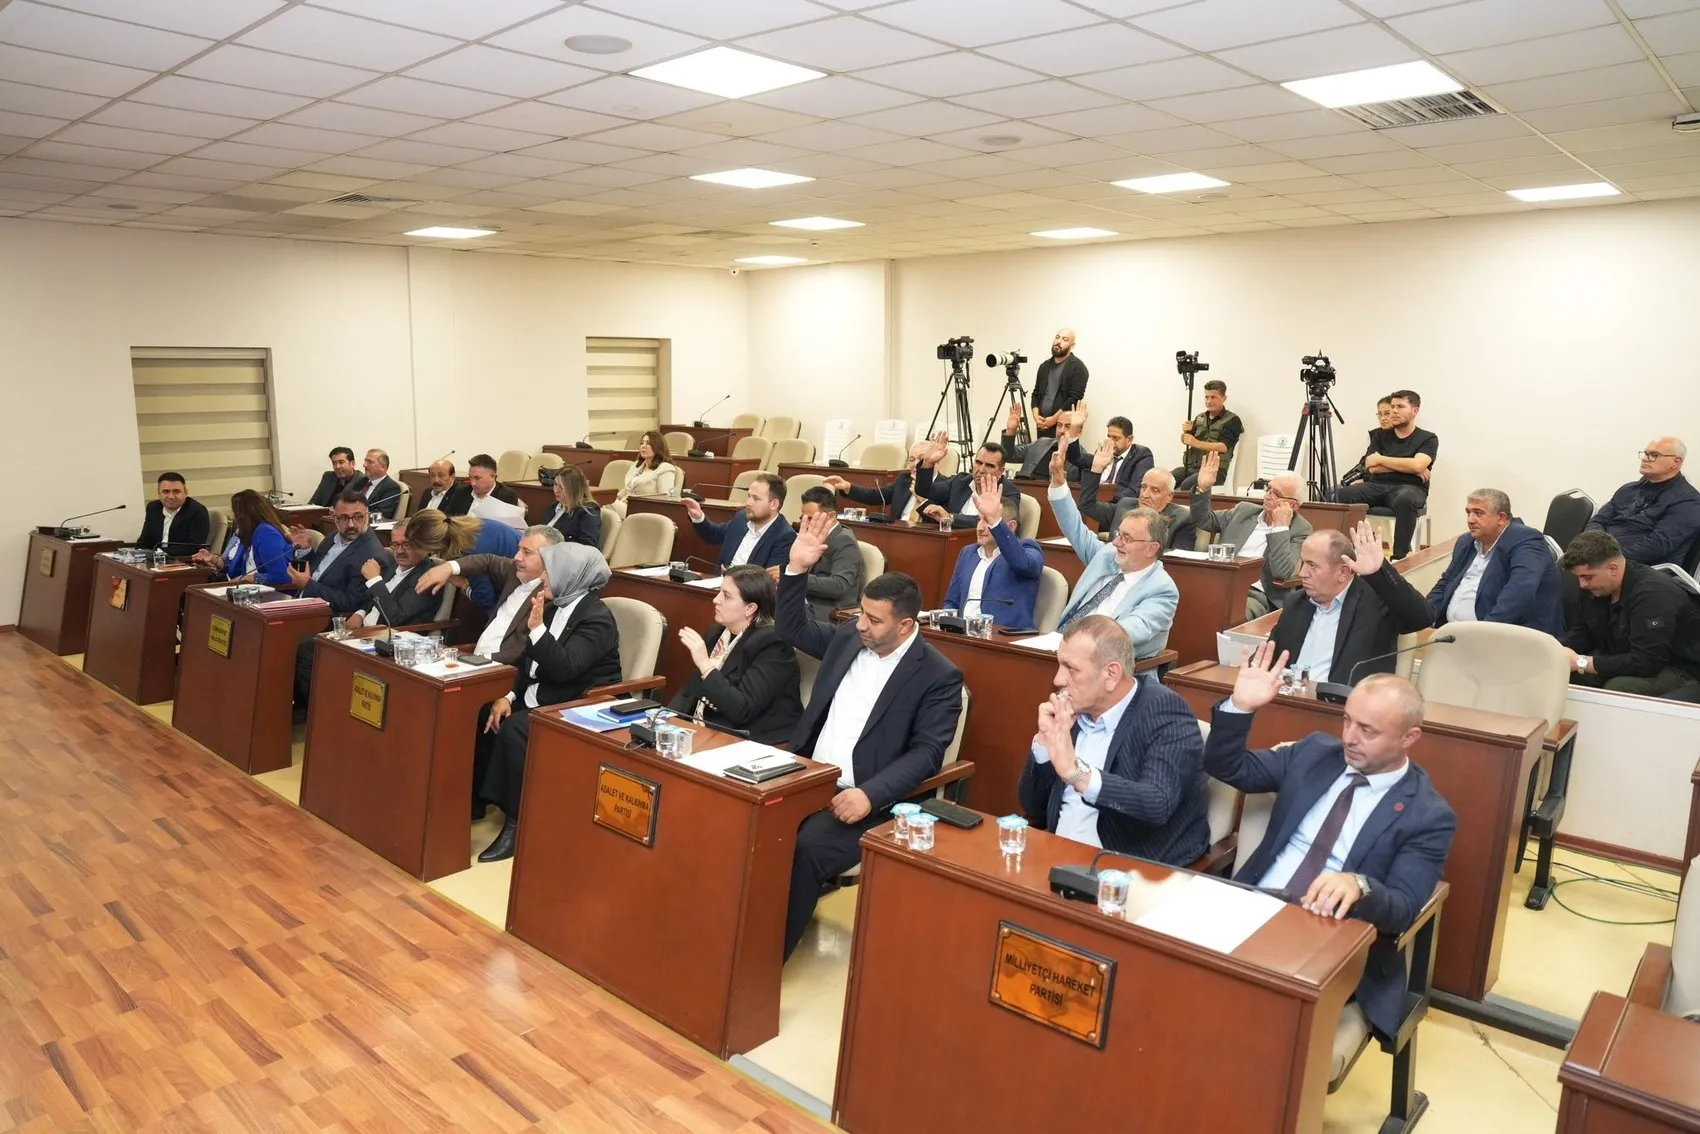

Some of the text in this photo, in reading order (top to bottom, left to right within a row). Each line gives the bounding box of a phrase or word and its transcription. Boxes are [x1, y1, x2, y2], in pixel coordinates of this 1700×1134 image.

[600, 784, 649, 811] ADALET VE KALKINMA
[1005, 952, 1097, 998] MİLLİYETÇİ HAREKET
[1029, 982, 1064, 1006] PARTİSİ
